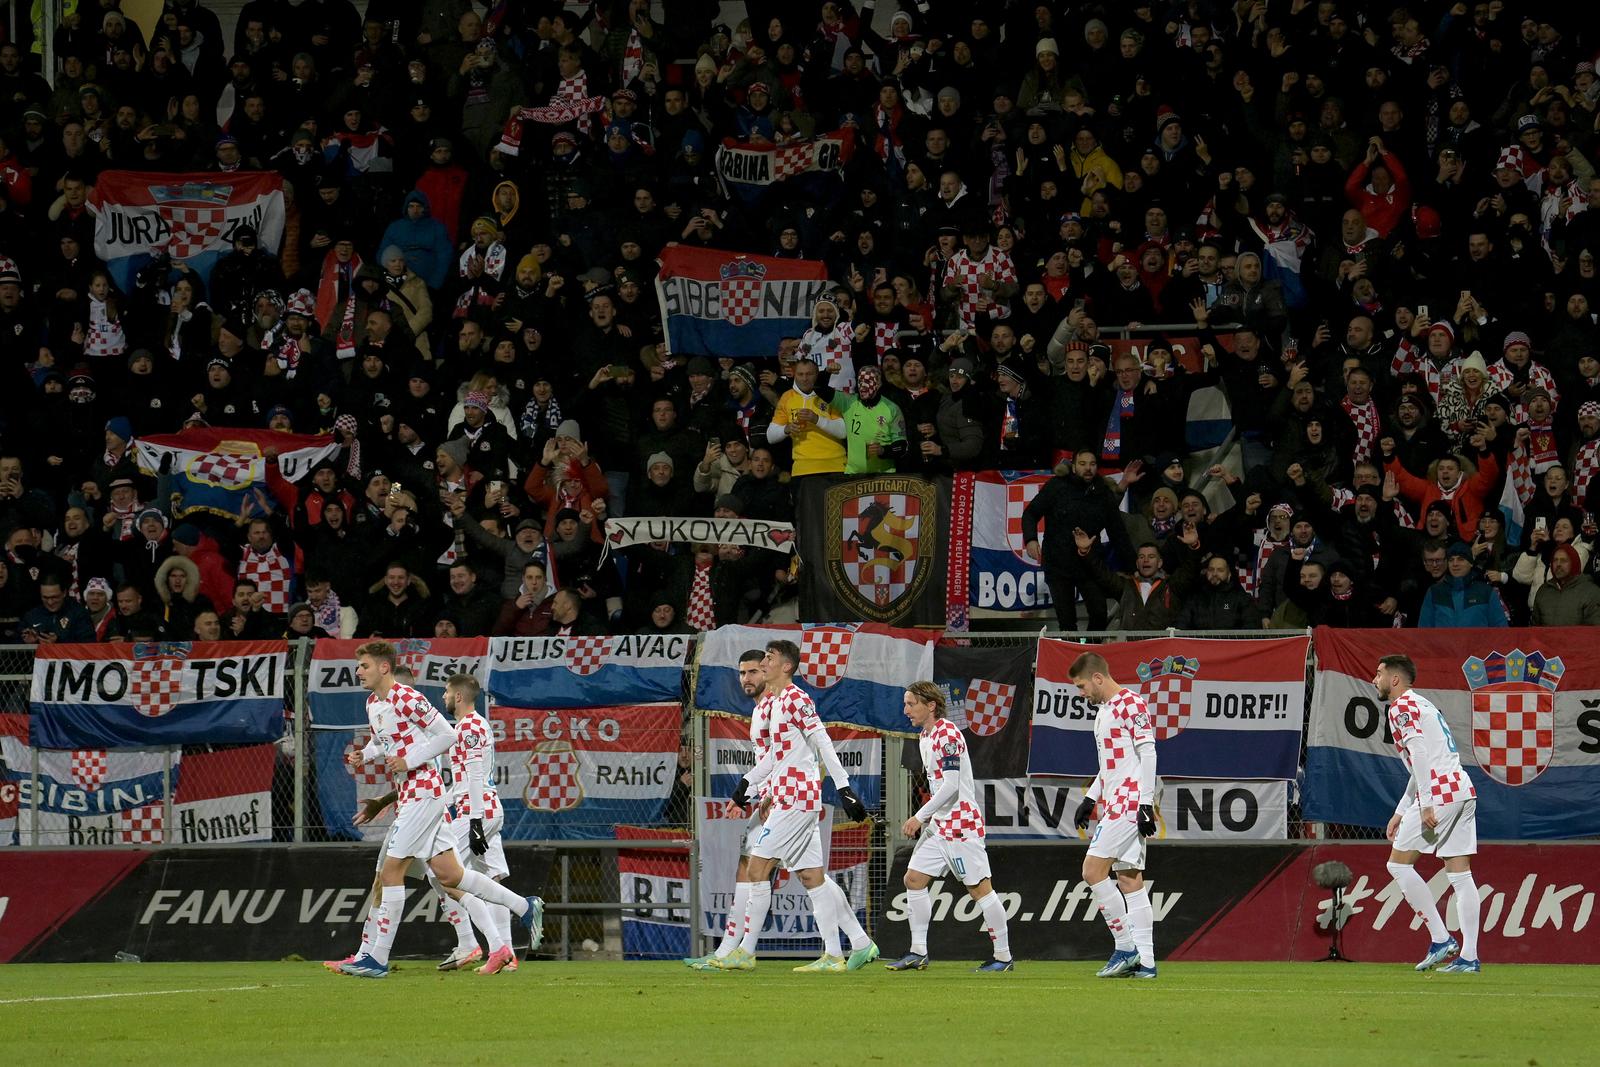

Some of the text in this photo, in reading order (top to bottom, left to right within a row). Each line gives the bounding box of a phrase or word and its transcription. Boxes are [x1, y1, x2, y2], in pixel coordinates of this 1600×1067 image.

[106, 211, 171, 244] JURA
[851, 418, 862, 436] 12
[856, 480, 909, 495] STUTTGART
[621, 519, 773, 547] VUKOVAR
[952, 477, 968, 597] SV CROATIA REUTLINGEN
[1205, 693, 1289, 720] DORF!!
[489, 710, 621, 742] BRČKO
[68, 799, 260, 845] Bad Honnef
[139, 888, 287, 924] FANU
